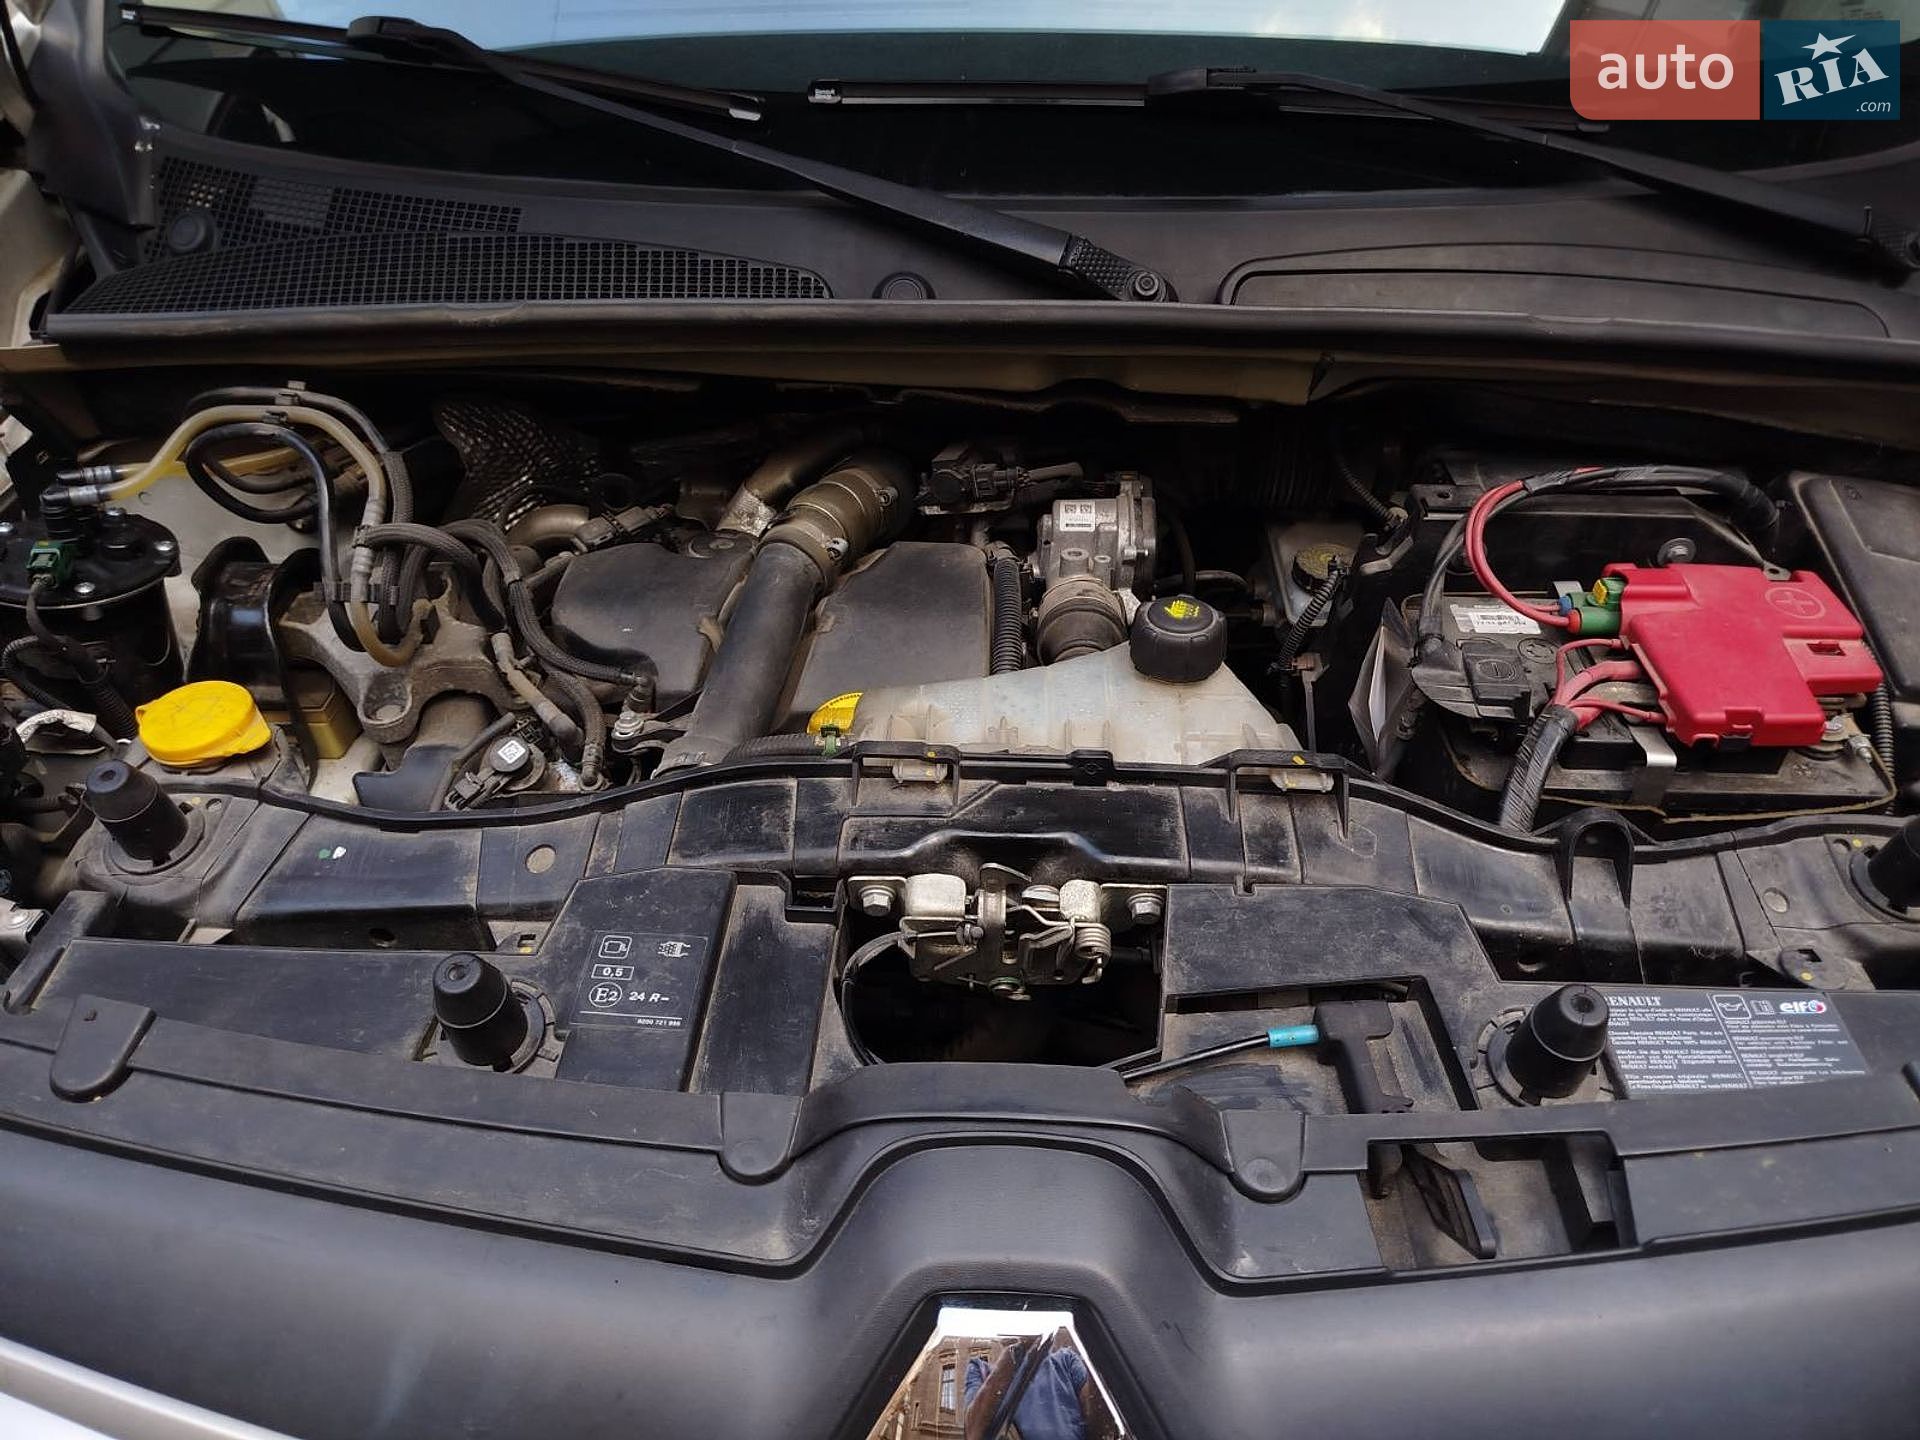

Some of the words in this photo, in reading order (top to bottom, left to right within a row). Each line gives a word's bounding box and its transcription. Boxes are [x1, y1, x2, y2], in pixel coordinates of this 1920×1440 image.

[594, 988, 618, 1002] E2
[628, 991, 645, 1001] 24
[1779, 1002, 1809, 1014] elf
